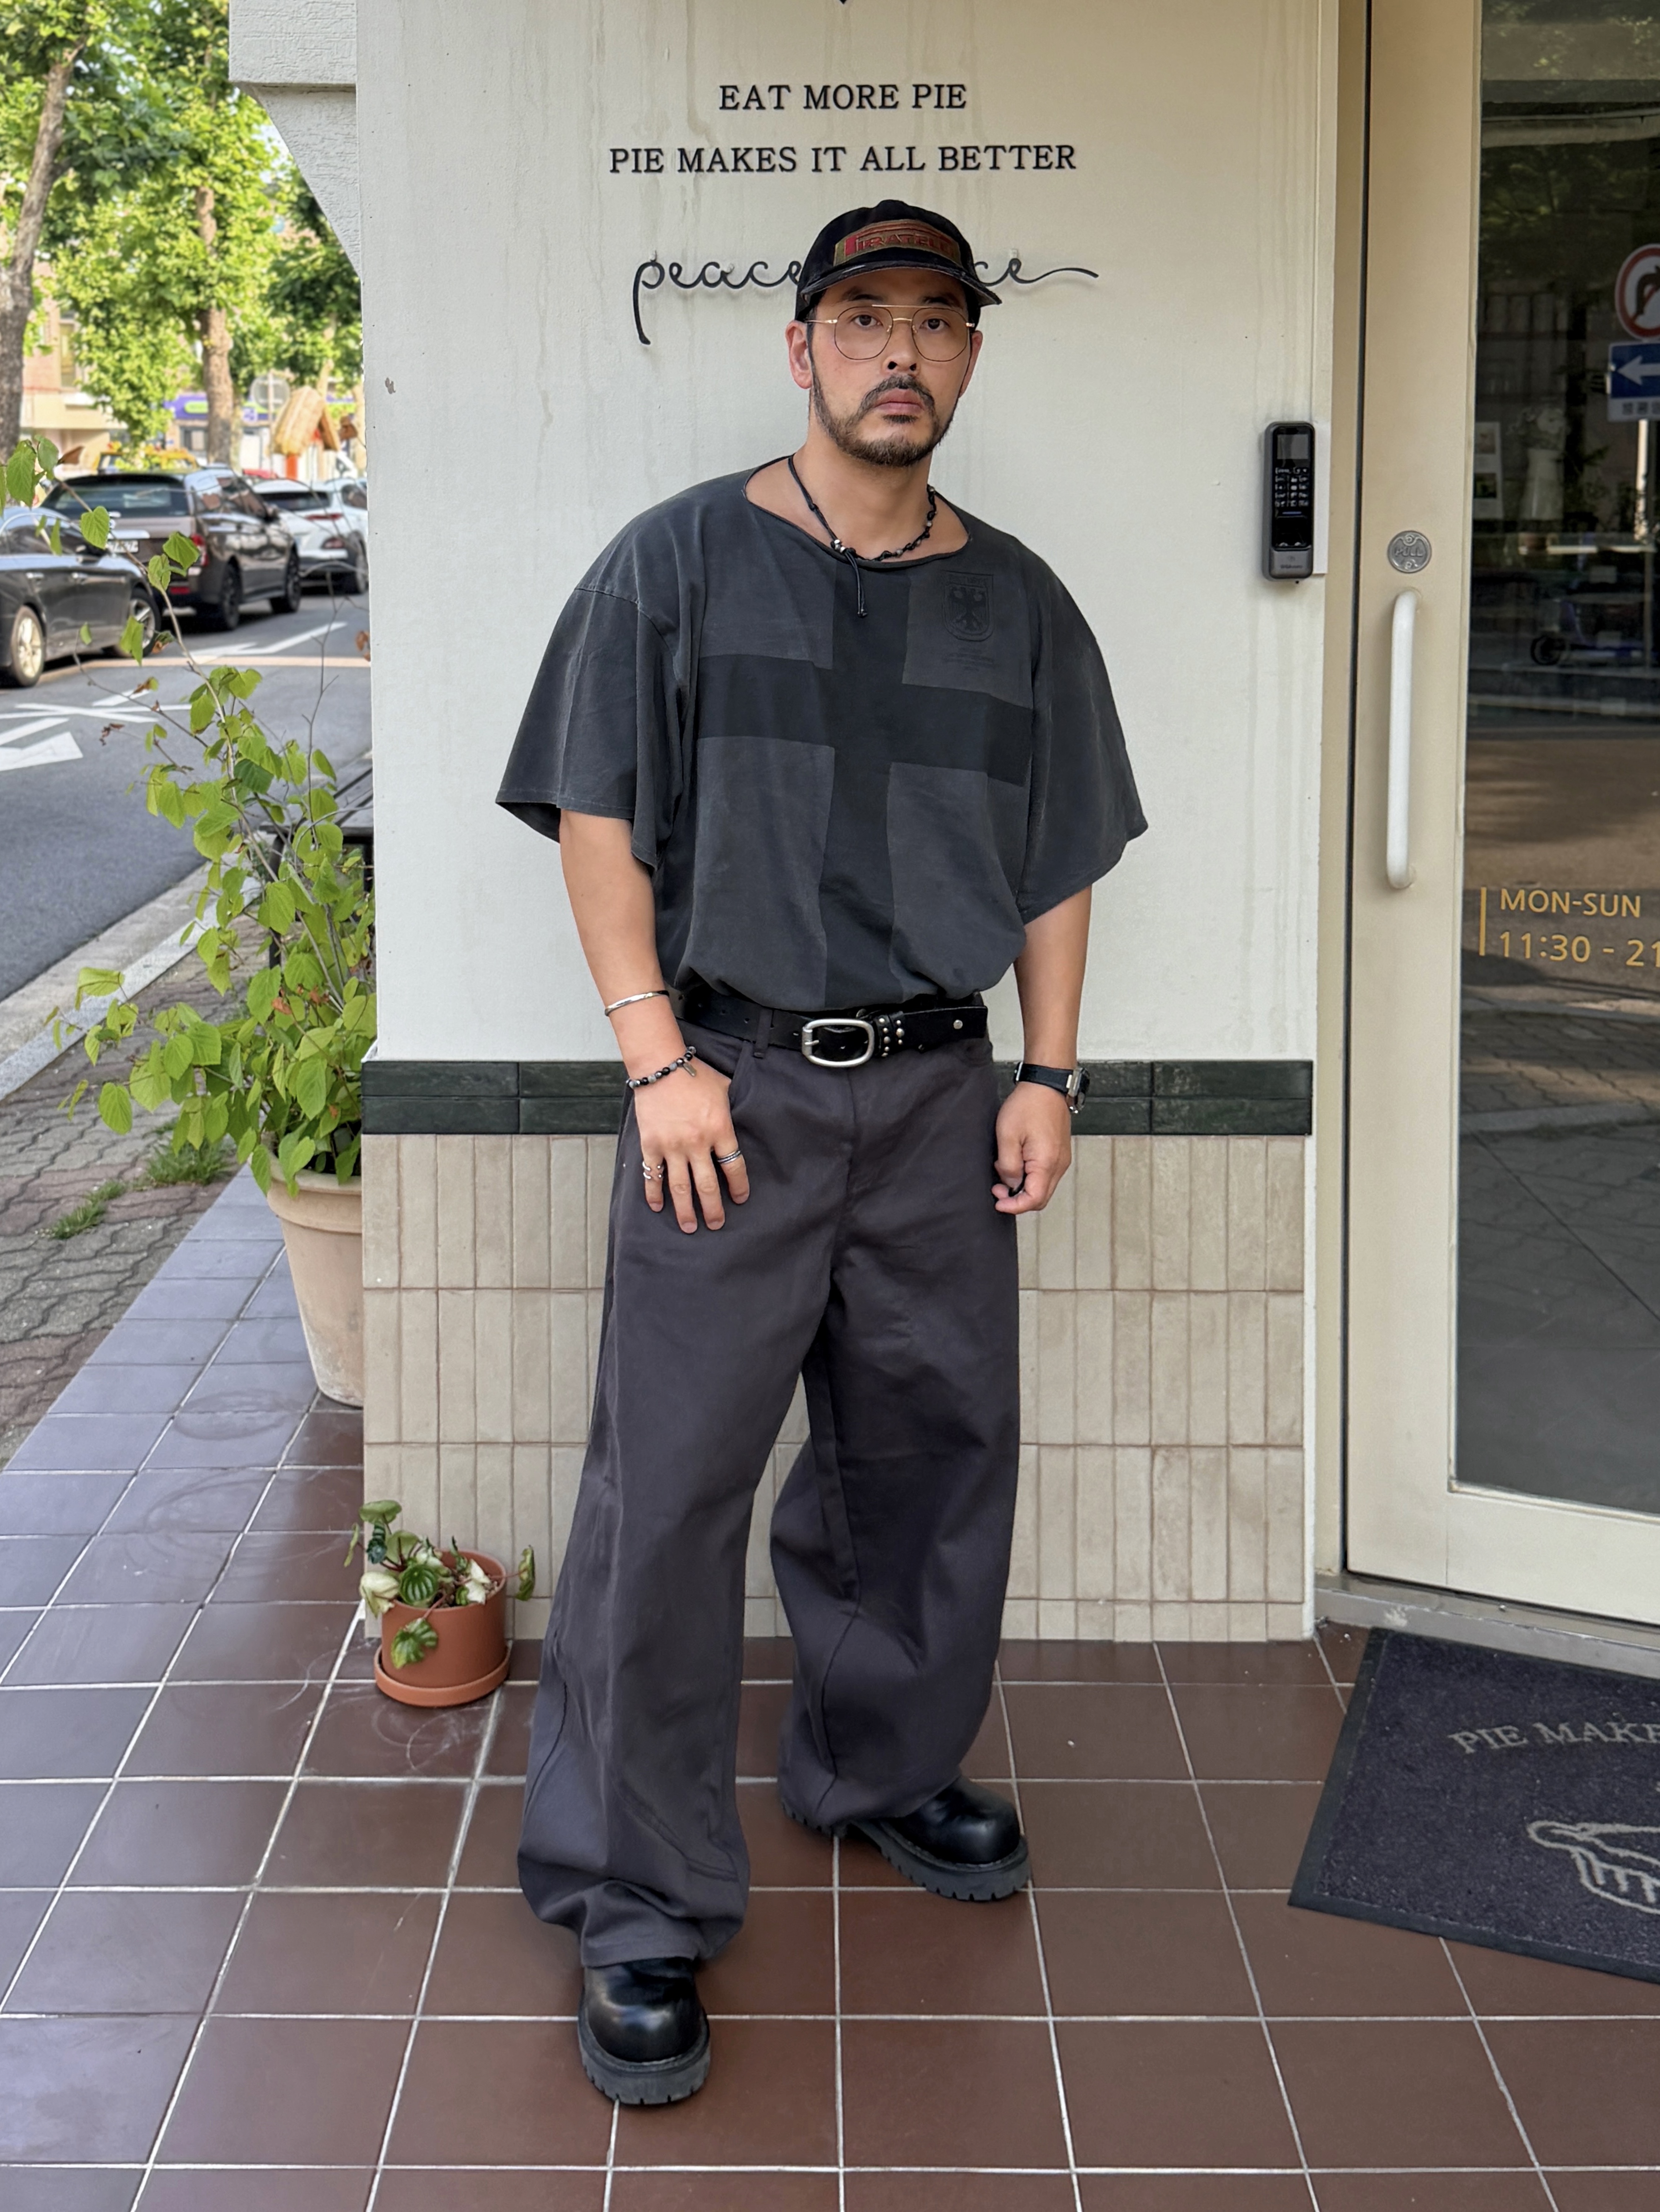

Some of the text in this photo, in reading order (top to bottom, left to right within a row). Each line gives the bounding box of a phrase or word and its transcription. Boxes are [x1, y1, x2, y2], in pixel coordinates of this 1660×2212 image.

[719, 84, 967, 110] EAT MORE PIE
[610, 145, 1076, 173] PIE MAKES IT ALL BETTER
[633, 258, 802, 345] peace
[1394, 546, 1424, 558] PULL
[1500, 888, 1641, 918] MON-SUN
[1500, 931, 1591, 963] 11:30
[1447, 1725, 1529, 1754] PIE
